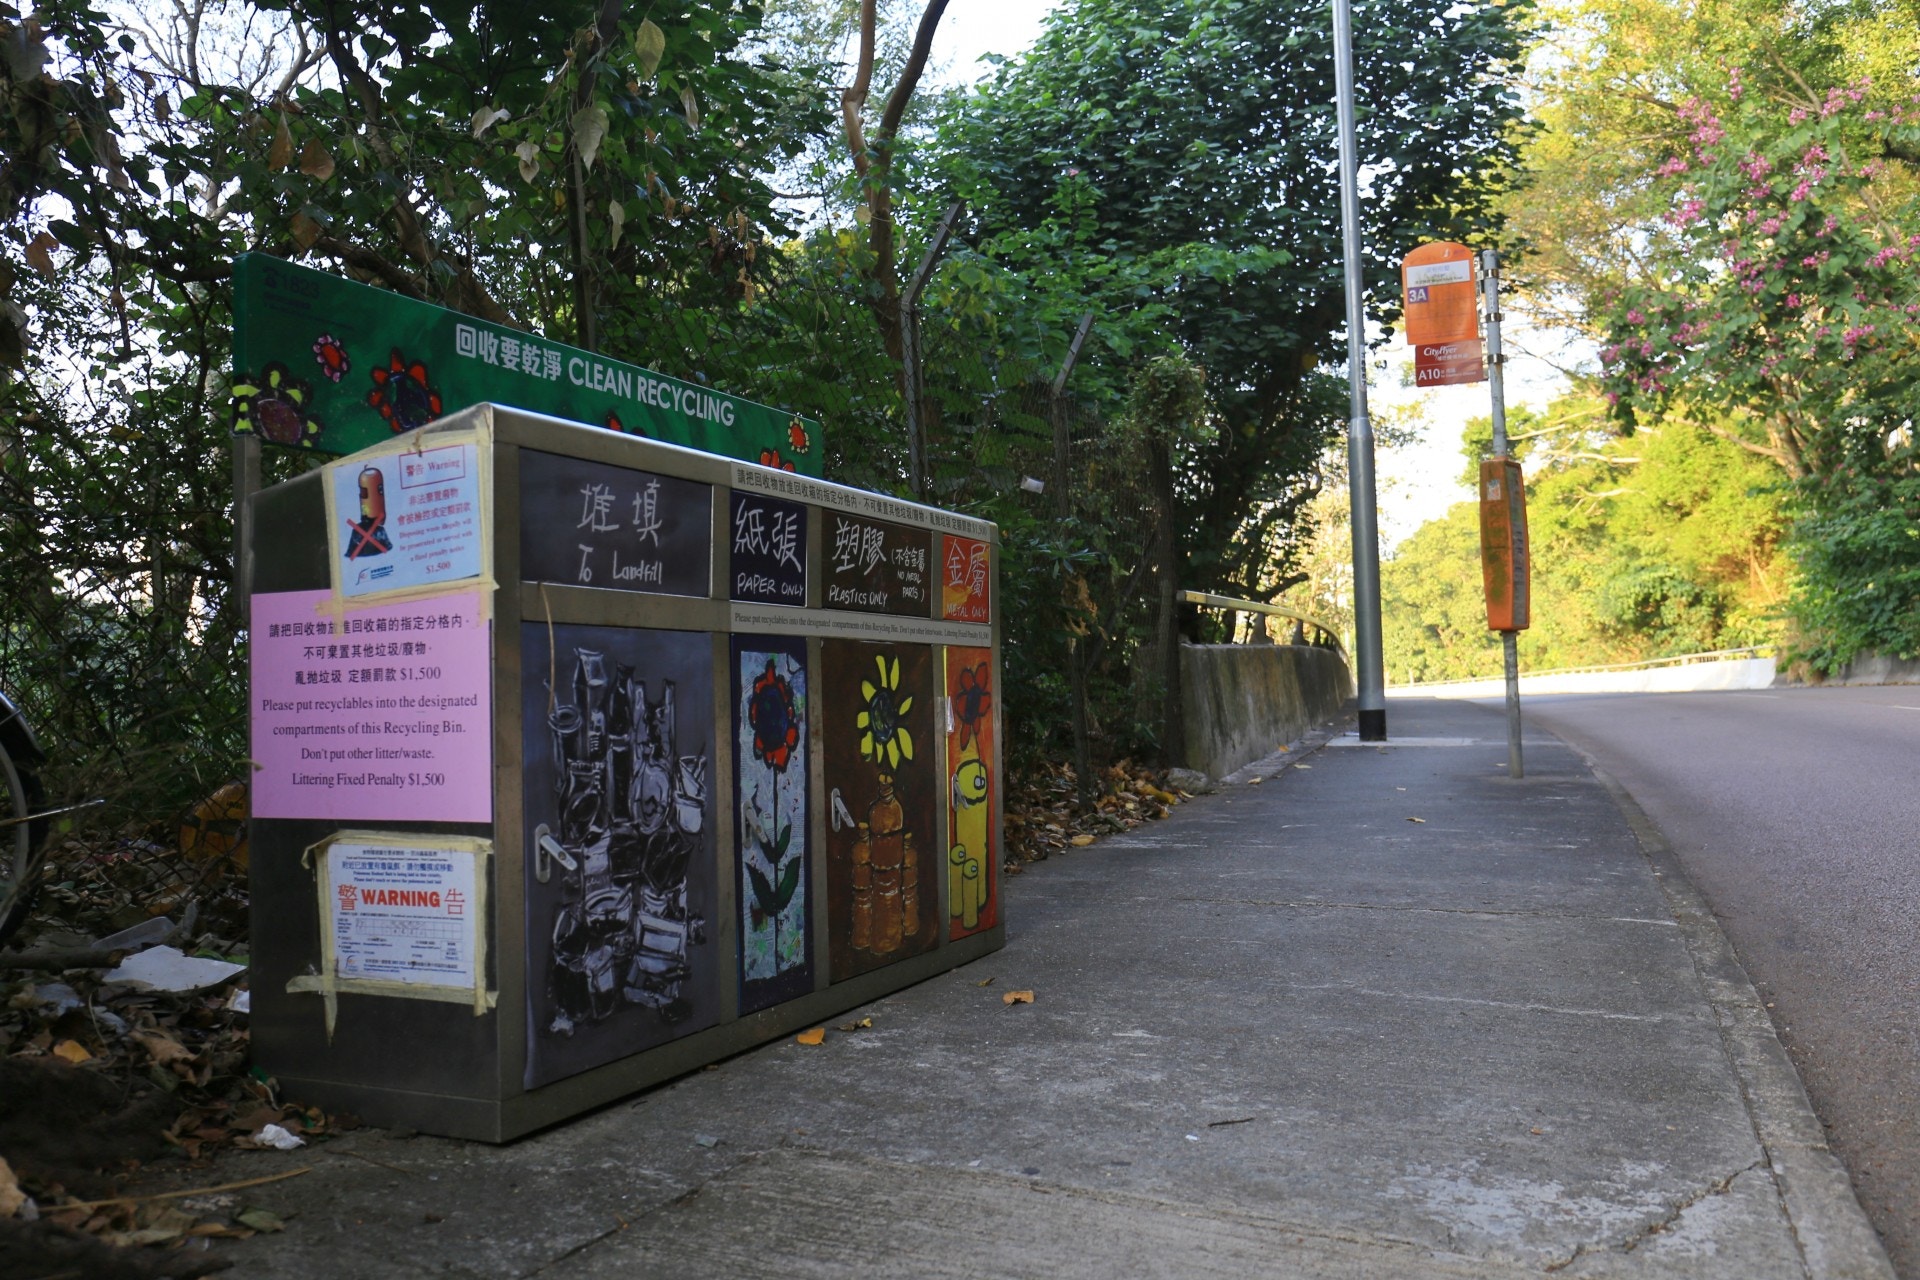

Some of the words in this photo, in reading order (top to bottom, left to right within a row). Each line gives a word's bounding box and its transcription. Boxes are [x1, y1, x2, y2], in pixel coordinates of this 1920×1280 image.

[1409, 289, 1427, 303] 3A
[456, 323, 562, 382] 回收要乾淨
[568, 356, 631, 400] CLEAN
[637, 375, 735, 427] RECYCLING
[1418, 368, 1440, 381] A10
[428, 459, 460, 471] Warning
[576, 478, 663, 548] 堆填
[734, 499, 802, 573] 紙張
[832, 517, 887, 576] 塑膠
[578, 543, 593, 583] To
[612, 550, 663, 585] Landfill
[947, 539, 986, 598] 金屬
[737, 572, 776, 596] PAPER
[781, 582, 804, 596] ONLY
[897, 570, 905, 580] NO
[829, 584, 867, 605] PLASTICS
[869, 591, 888, 608] ONLY
[947, 603, 968, 617] METAL
[971, 606, 987, 619] ONLY
[348, 667, 397, 684] 定額罰款
[400, 665, 442, 682] $1,500
[262, 699, 294, 711] Please
[296, 700, 313, 713] put
[314, 697, 373, 713] recyclables
[375, 697, 397, 709] into
[399, 695, 416, 708] the
[418, 693, 478, 710] designated
[272, 723, 346, 739] compartments
[347, 721, 361, 735] of
[361, 721, 381, 735] this
[384, 720, 440, 737] Recycling
[442, 720, 466, 734] Bin.
[301, 747, 329, 760] Don't
[329, 749, 346, 762] put
[347, 747, 373, 760] other
[375, 746, 435, 760] litter/waste.
[292, 772, 335, 788] Littering
[336, 772, 365, 786] Fixed
[367, 772, 406, 789] Penalty
[408, 772, 445, 787] $1,500
[338, 884, 358, 911] 警
[361, 888, 441, 908] WARNING
[444, 888, 465, 915] 告
